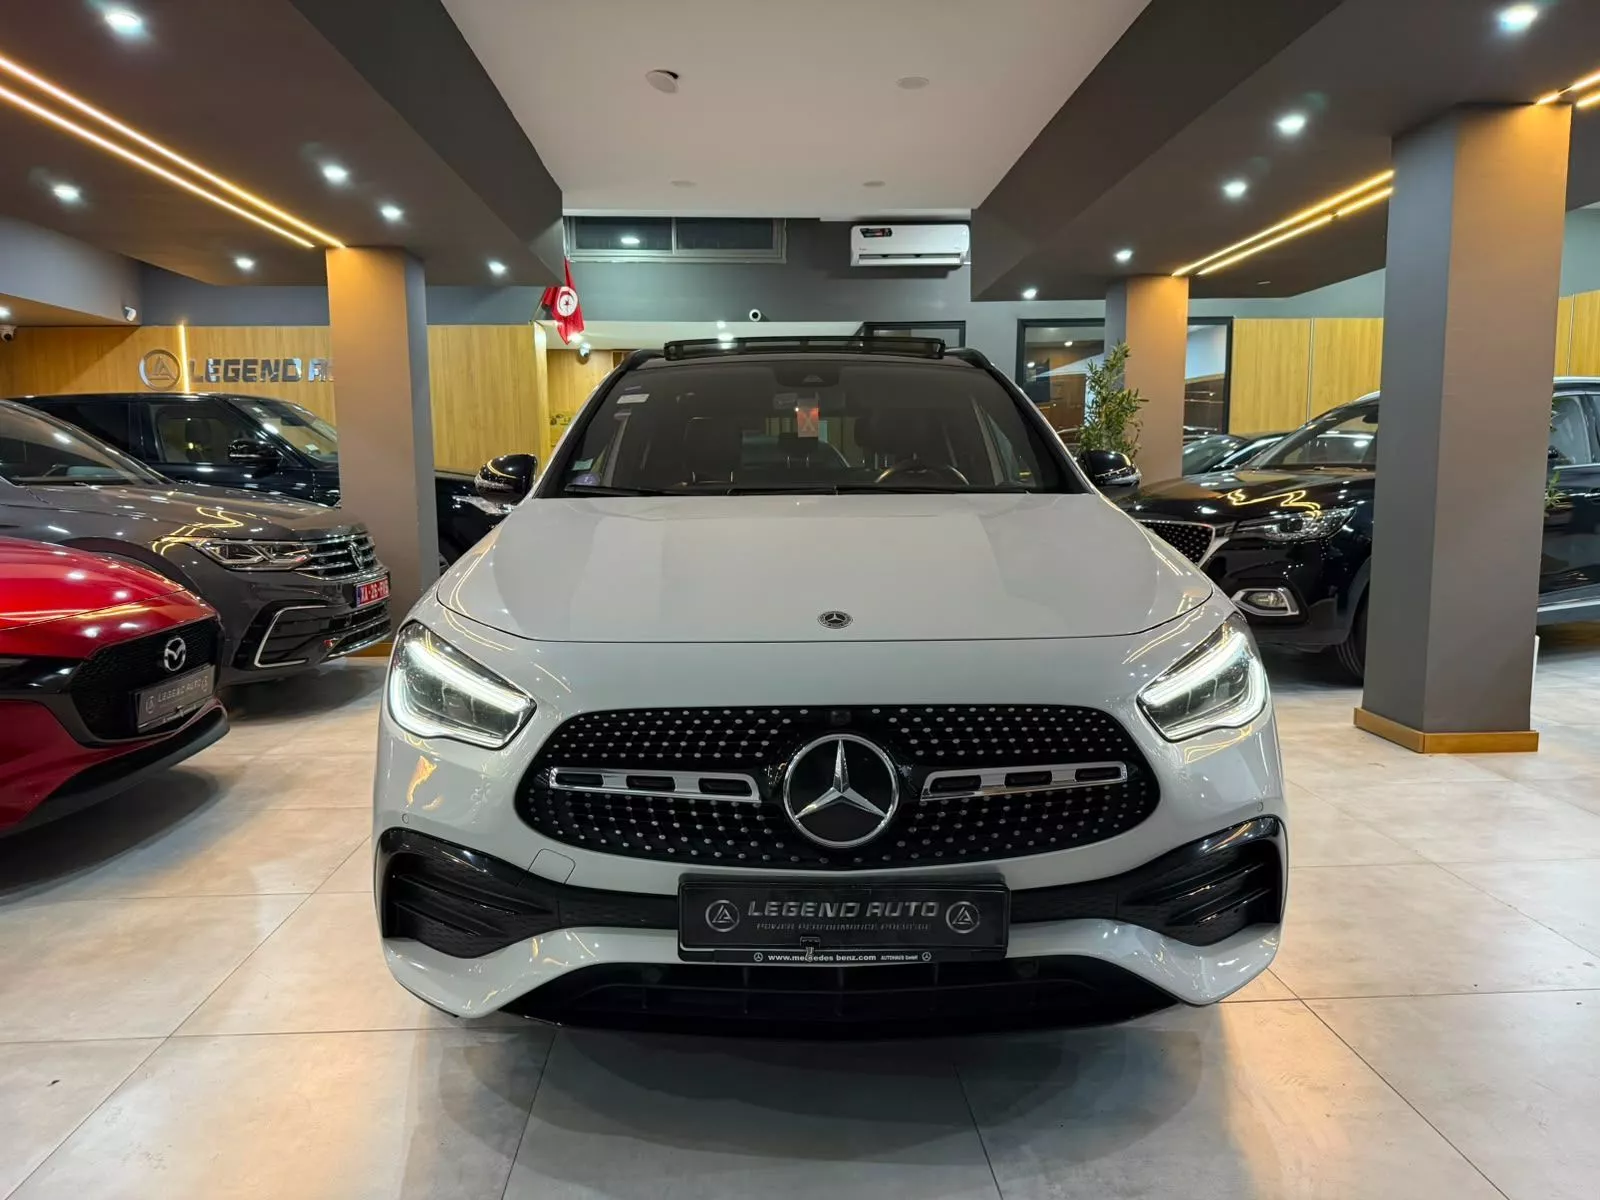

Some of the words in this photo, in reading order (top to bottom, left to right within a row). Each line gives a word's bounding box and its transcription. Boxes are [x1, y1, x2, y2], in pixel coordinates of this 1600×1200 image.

[189, 358, 302, 383] LEGEND
[748, 901, 860, 917] LEGEND
[866, 901, 939, 917] AUTO
